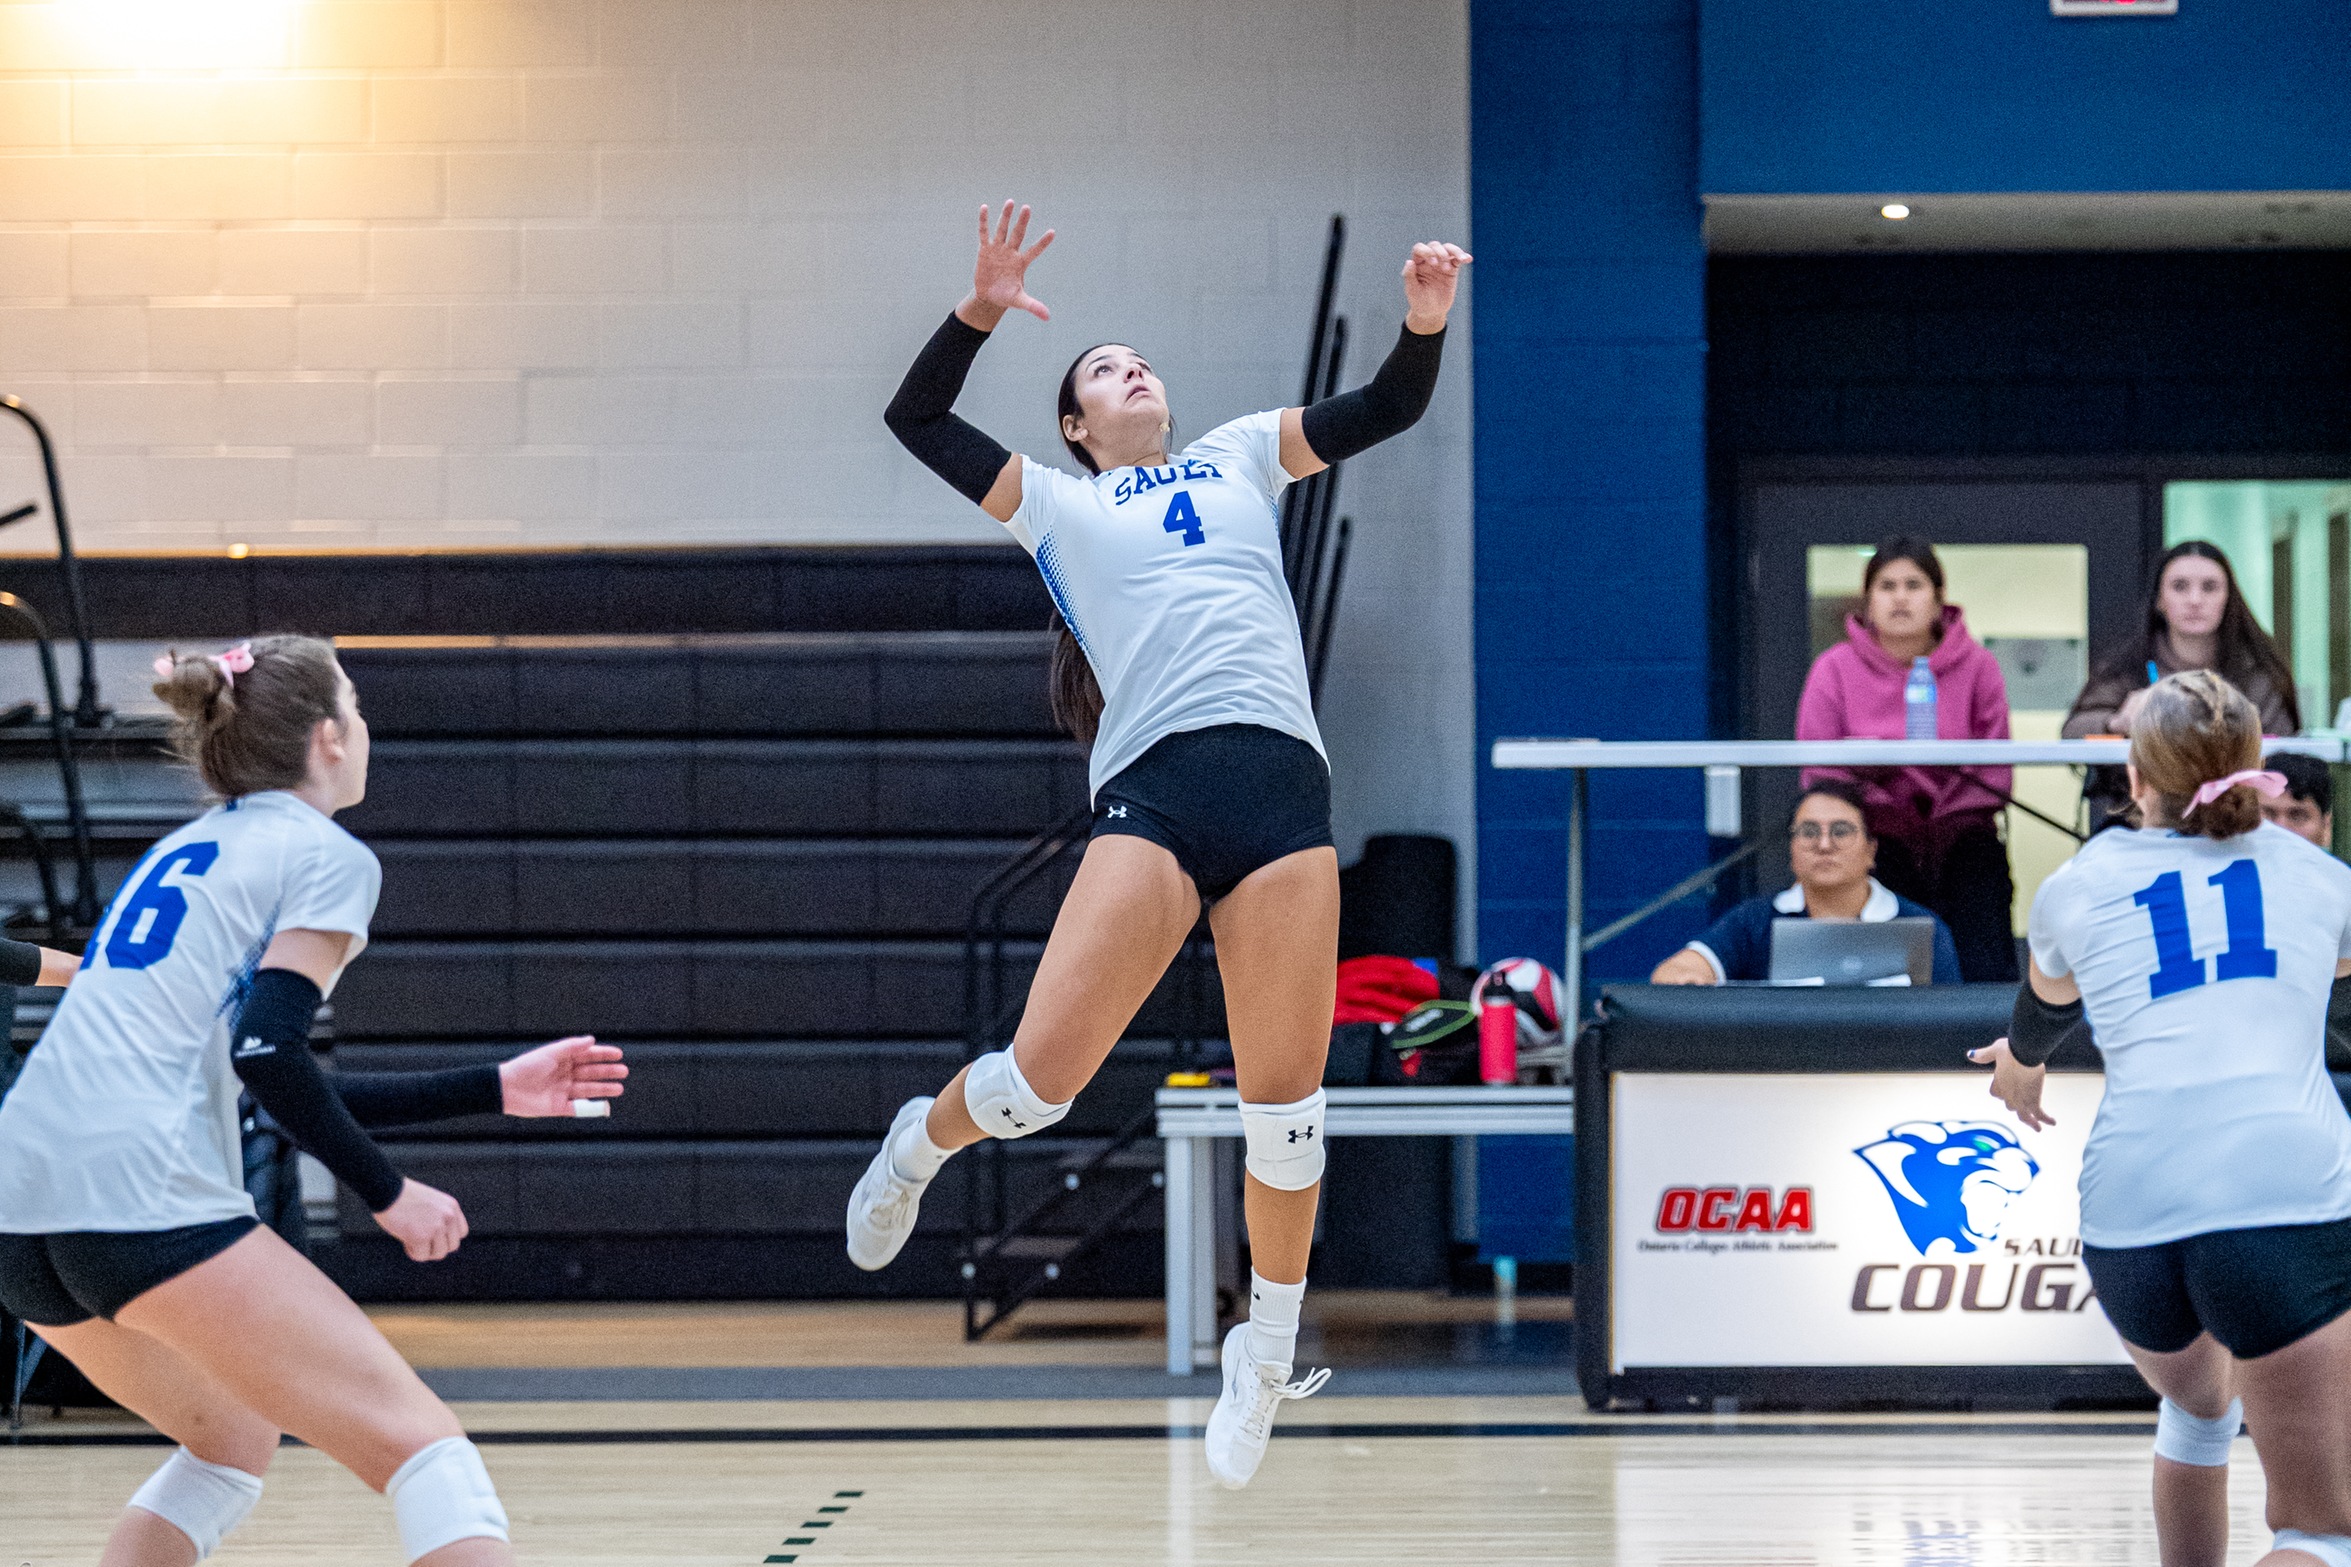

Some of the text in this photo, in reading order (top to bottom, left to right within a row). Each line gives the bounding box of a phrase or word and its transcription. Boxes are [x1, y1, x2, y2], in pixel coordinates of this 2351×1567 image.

[1163, 491, 1206, 547] 4
[2132, 858, 2278, 1001] 11
[1657, 1187, 1814, 1234] OCAA
